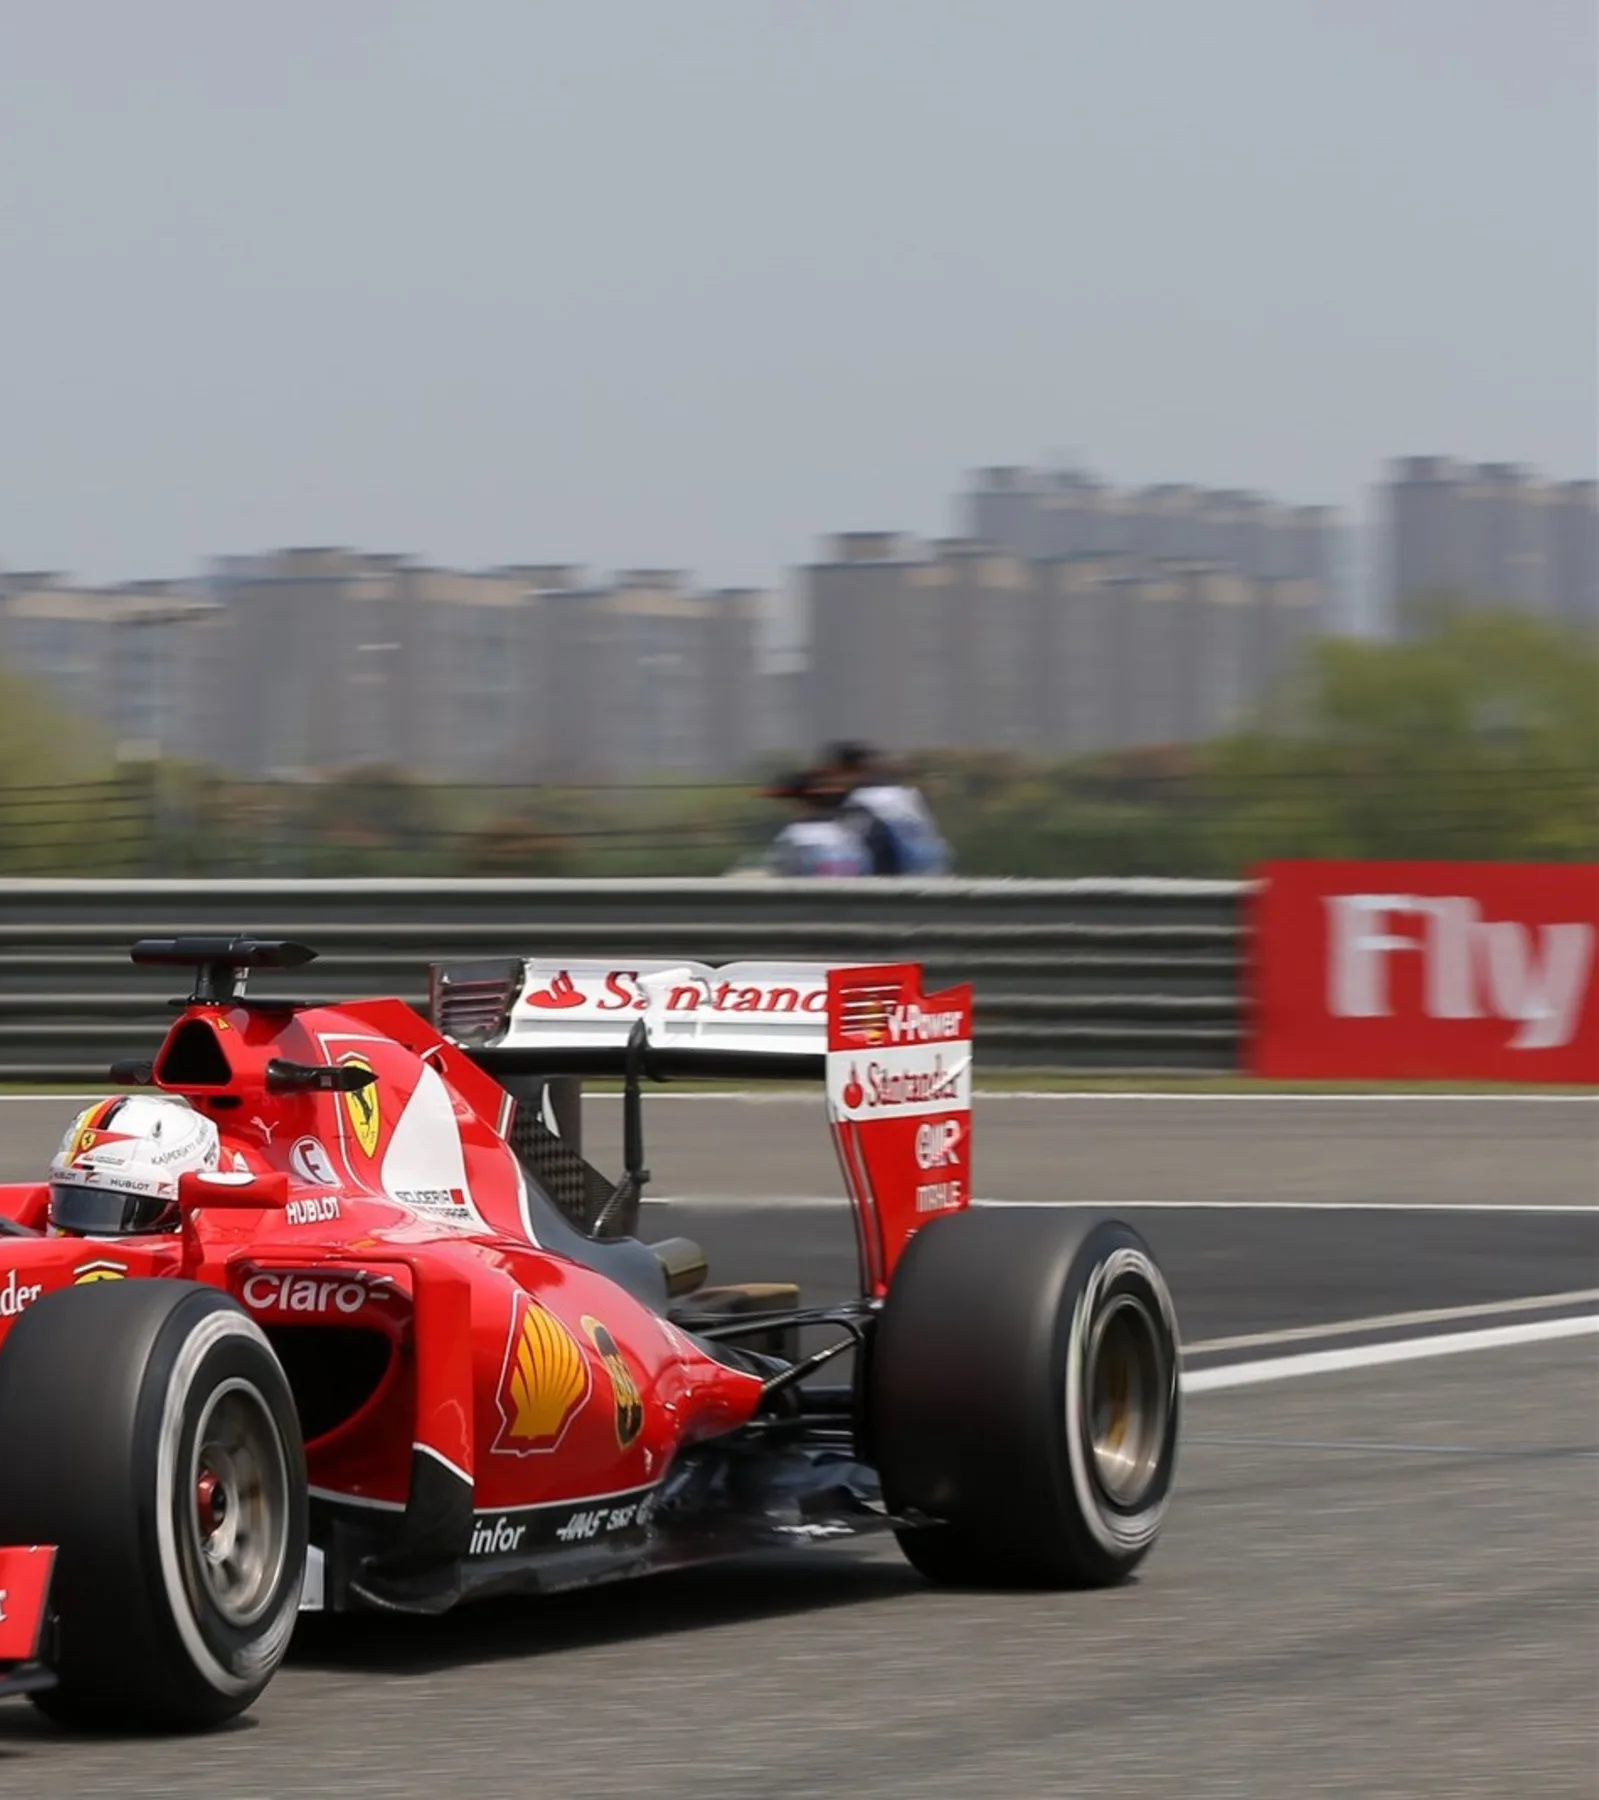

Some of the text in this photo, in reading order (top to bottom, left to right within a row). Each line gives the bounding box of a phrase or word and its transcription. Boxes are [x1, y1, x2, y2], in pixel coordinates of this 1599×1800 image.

[1320, 893, 1596, 1048] Fly
[110, 1179, 149, 1191] HUBLOT
[285, 1196, 340, 1225] HUBLOT
[243, 1270, 367, 1313] Claro
[469, 1516, 526, 1554] infor
